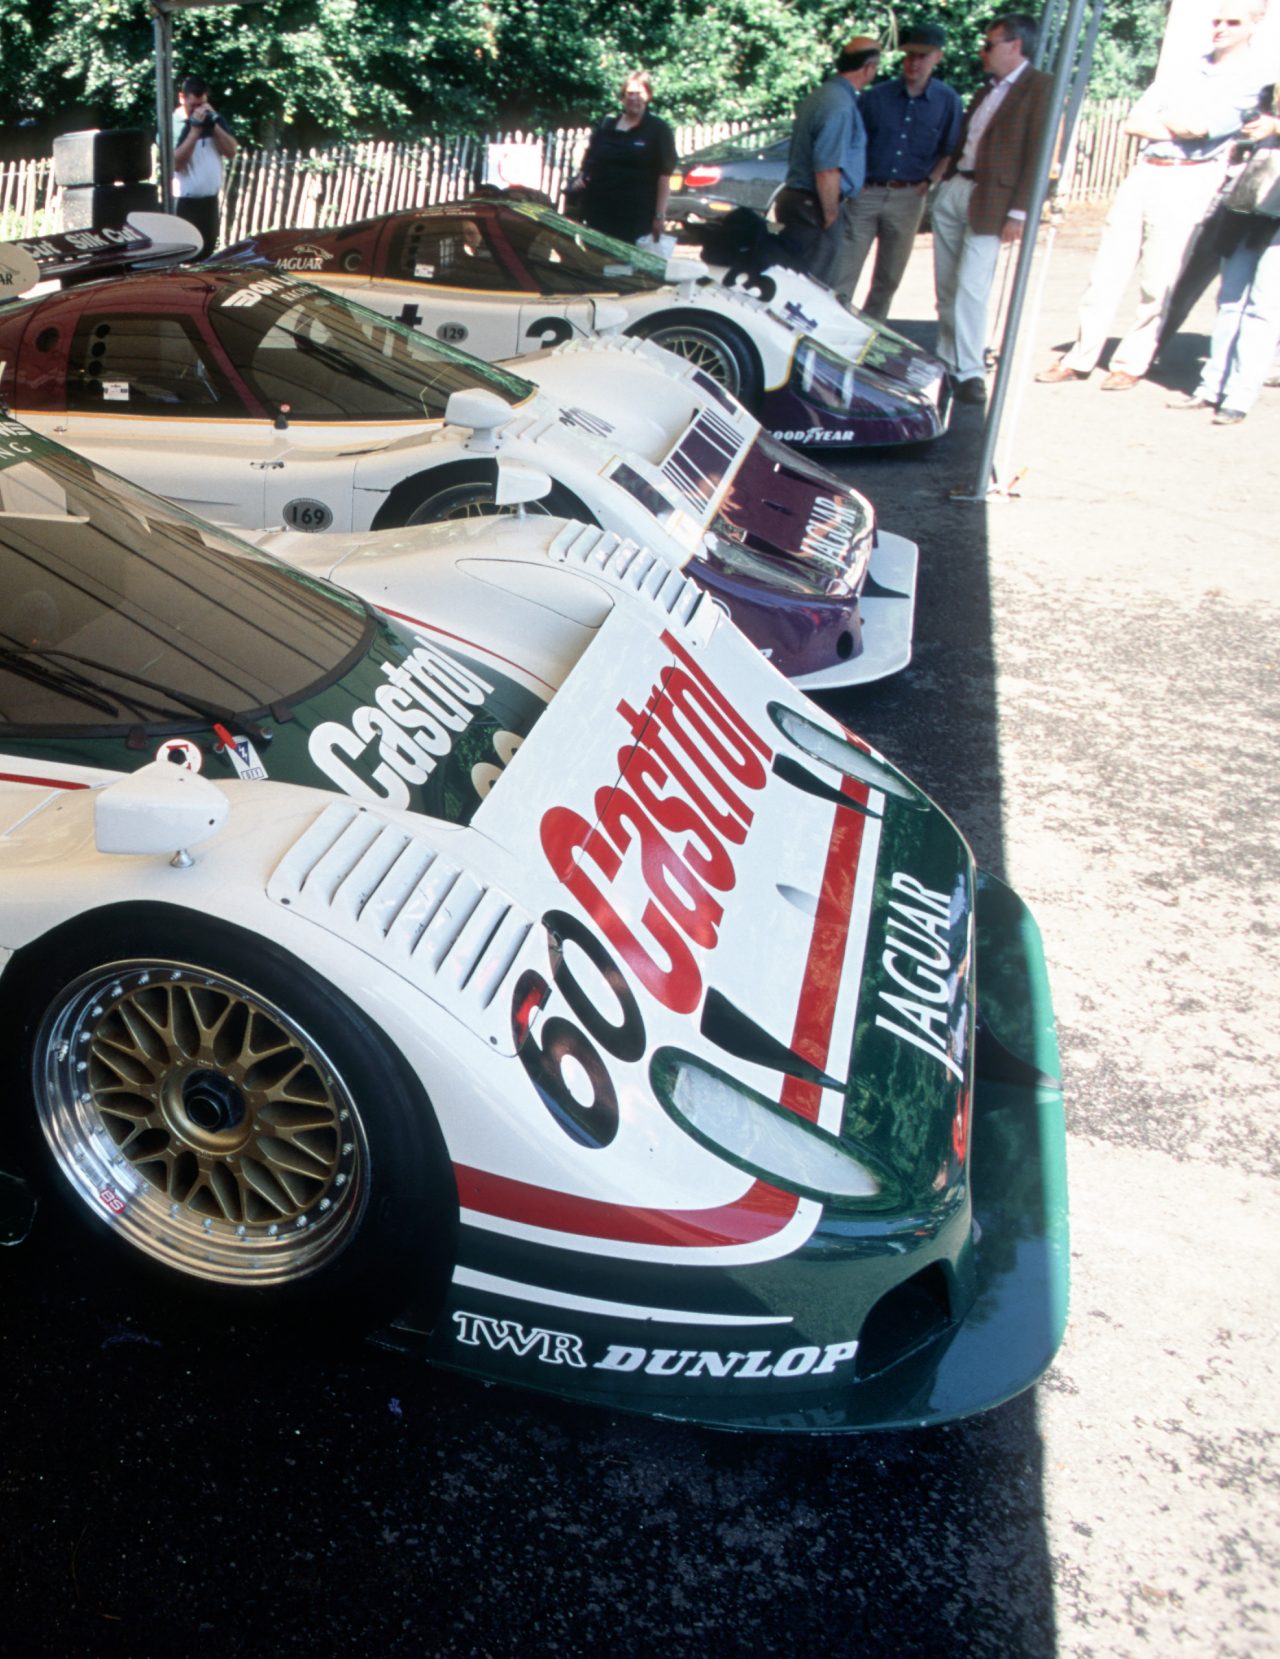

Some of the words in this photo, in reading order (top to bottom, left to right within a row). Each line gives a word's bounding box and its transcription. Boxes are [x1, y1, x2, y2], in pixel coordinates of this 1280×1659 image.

[16, 240, 61, 259] Cut
[64, 232, 109, 250] Silk
[101, 226, 142, 243] Cut
[276, 256, 324, 271] JAGUAR
[443, 326, 466, 340] 129
[766, 427, 855, 444] OODYEAR
[292, 506, 325, 526] 169
[800, 496, 857, 570] JAGUAR
[308, 636, 495, 810] Castrol
[540, 628, 773, 1015] Castrol
[875, 871, 964, 1084] JAGUAR
[511, 909, 647, 1149] 60
[452, 1310, 587, 1368] TWR
[594, 1339, 858, 1378] DUNLOP
